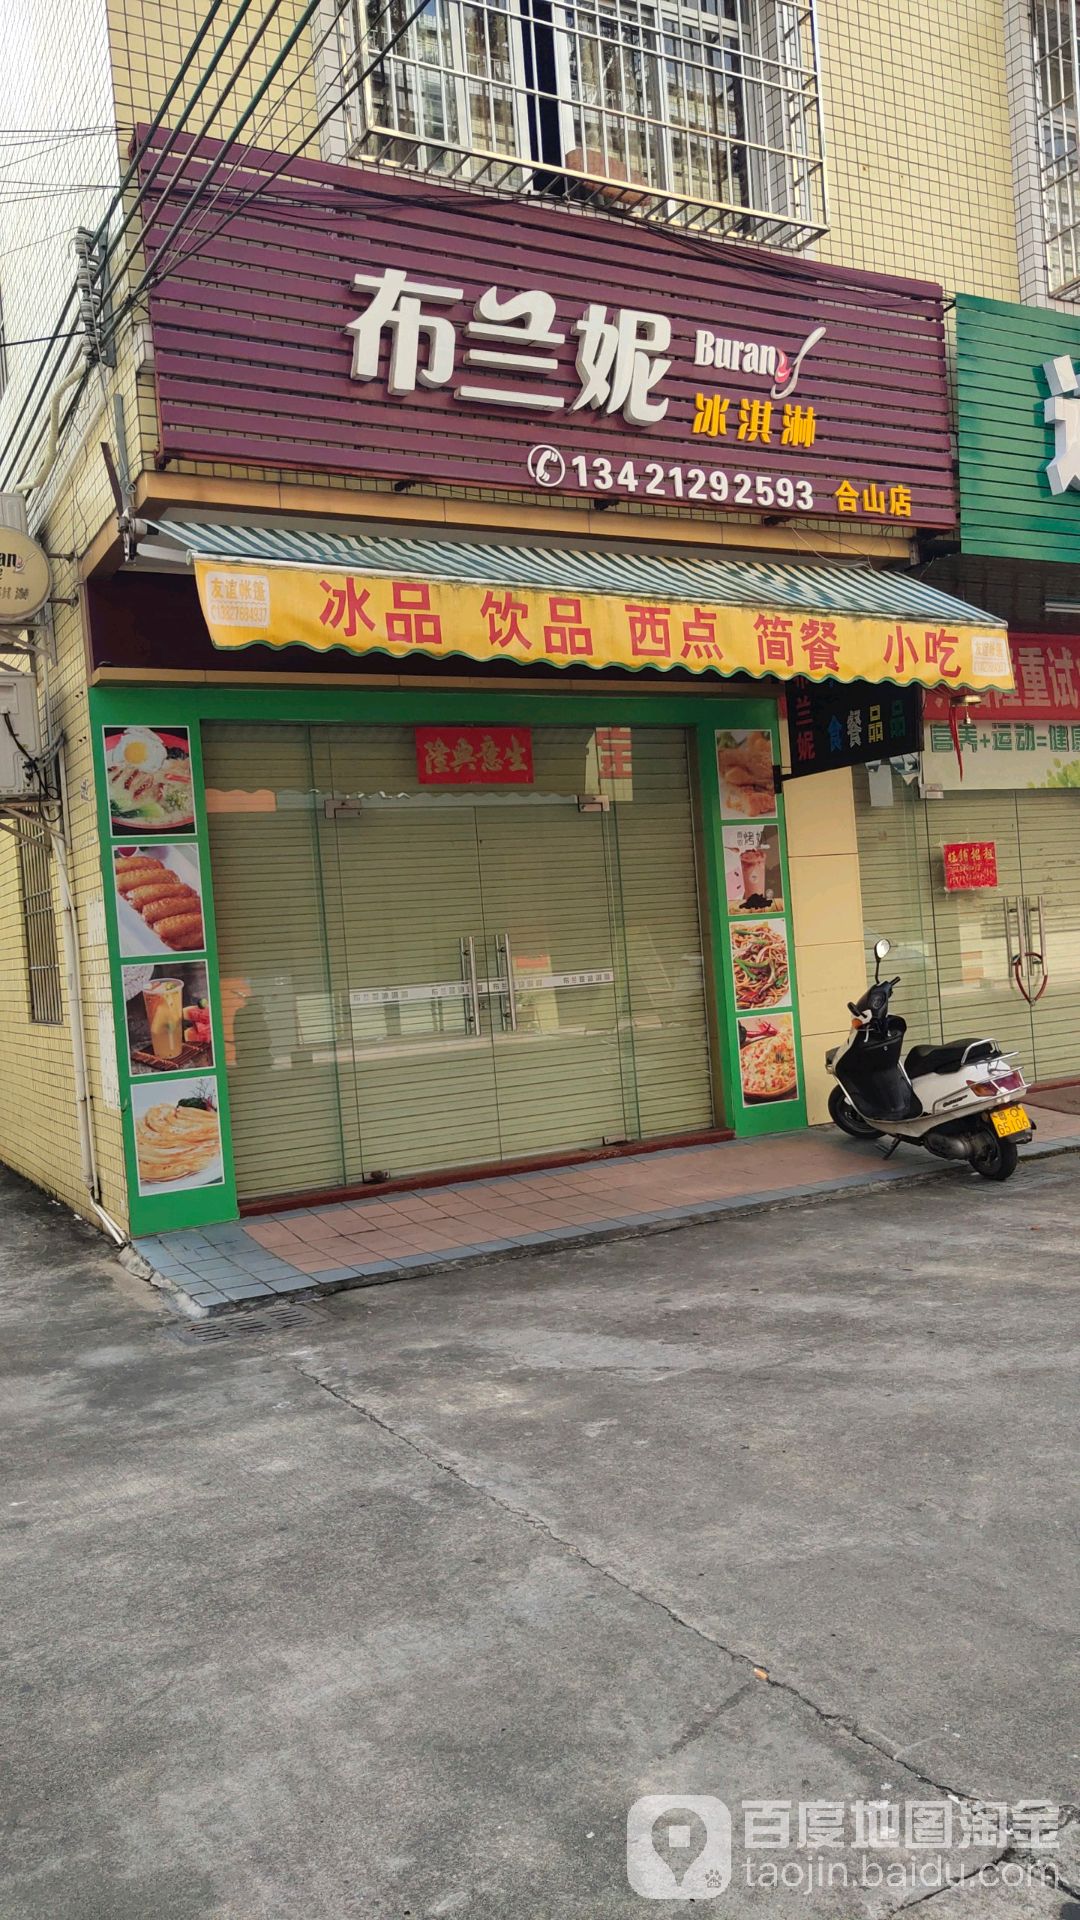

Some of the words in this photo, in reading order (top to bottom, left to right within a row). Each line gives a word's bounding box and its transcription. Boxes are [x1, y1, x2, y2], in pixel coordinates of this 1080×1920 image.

[344, 267, 673, 427] 布兰妮
[692, 392, 816, 448] 冰淇淋
[570, 454, 814, 511] 13421292593
[834, 480, 913, 517] 合山店
[318, 577, 443, 645] 冰品
[481, 590, 594, 657] 饮品
[625, 603, 724, 661] 西点
[753, 612, 842, 672] 简餐
[884, 624, 963, 680] 小吃
